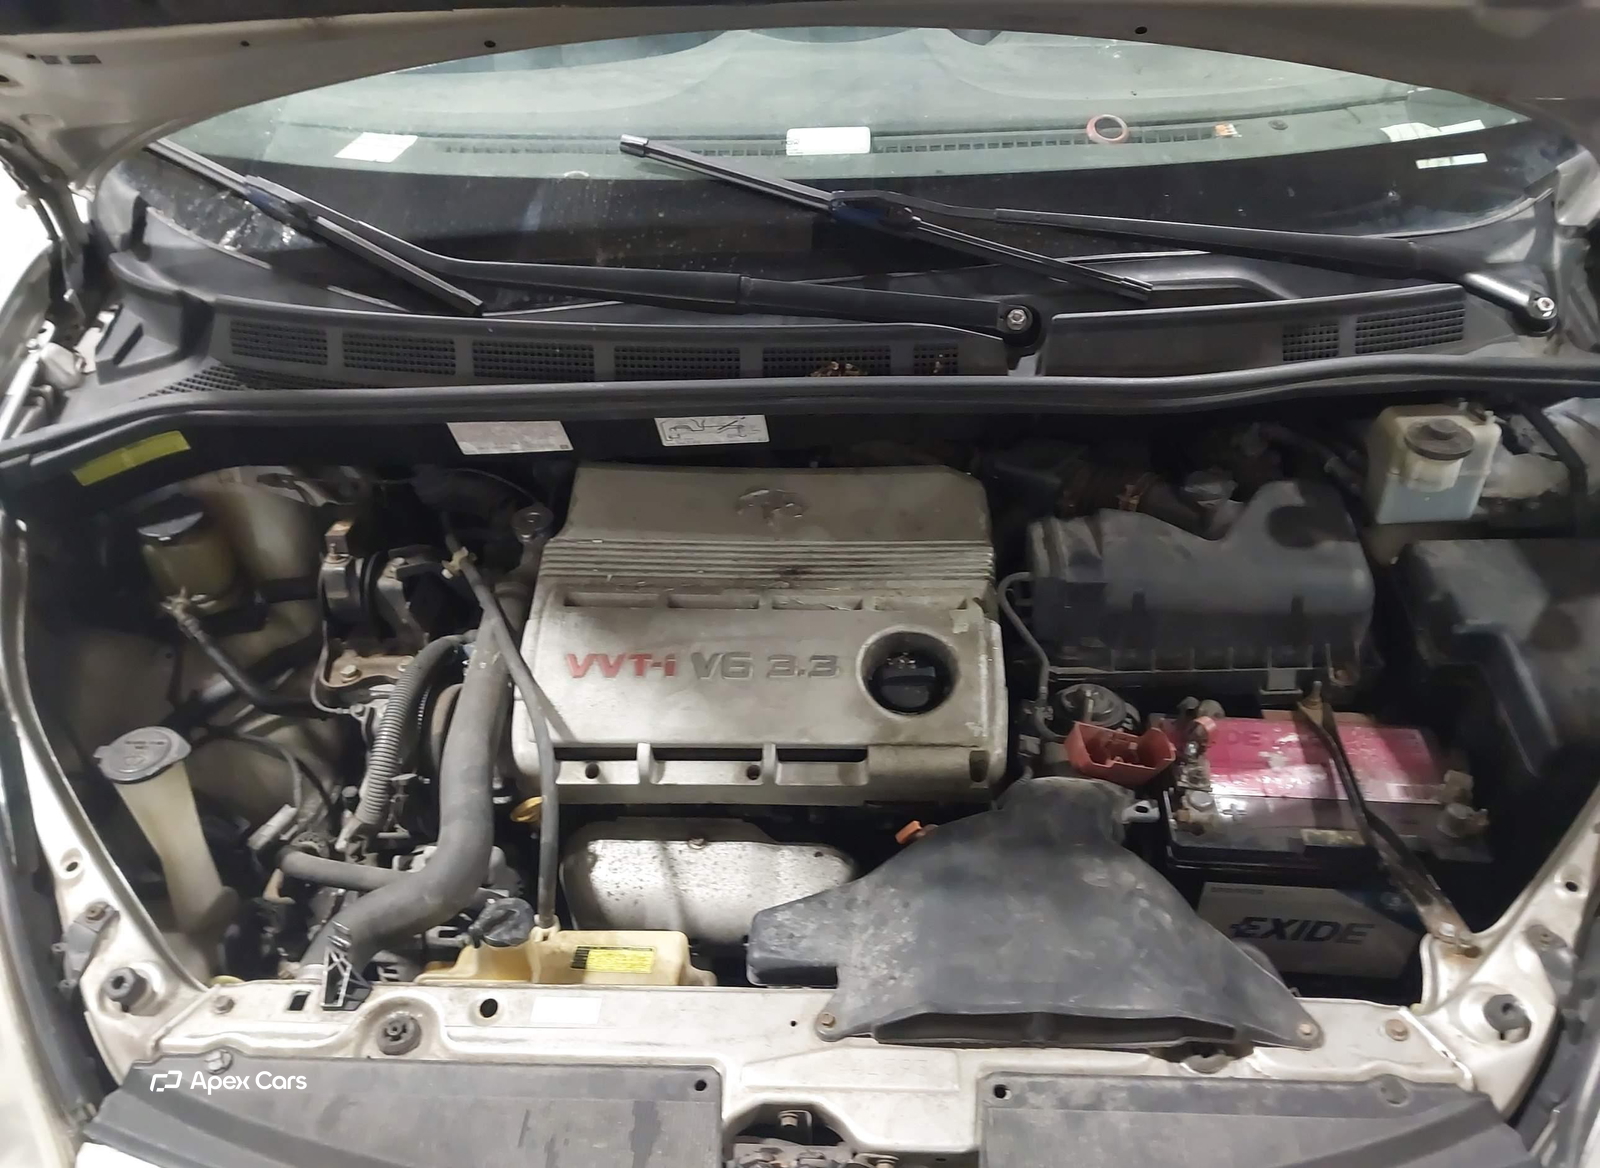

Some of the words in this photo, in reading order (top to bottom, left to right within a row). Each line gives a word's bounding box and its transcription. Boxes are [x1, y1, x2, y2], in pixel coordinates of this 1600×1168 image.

[566, 652, 677, 679] VVT-i
[690, 651, 754, 680] V6
[766, 653, 841, 679] 3.3
[1230, 916, 1376, 945] EXIDE
